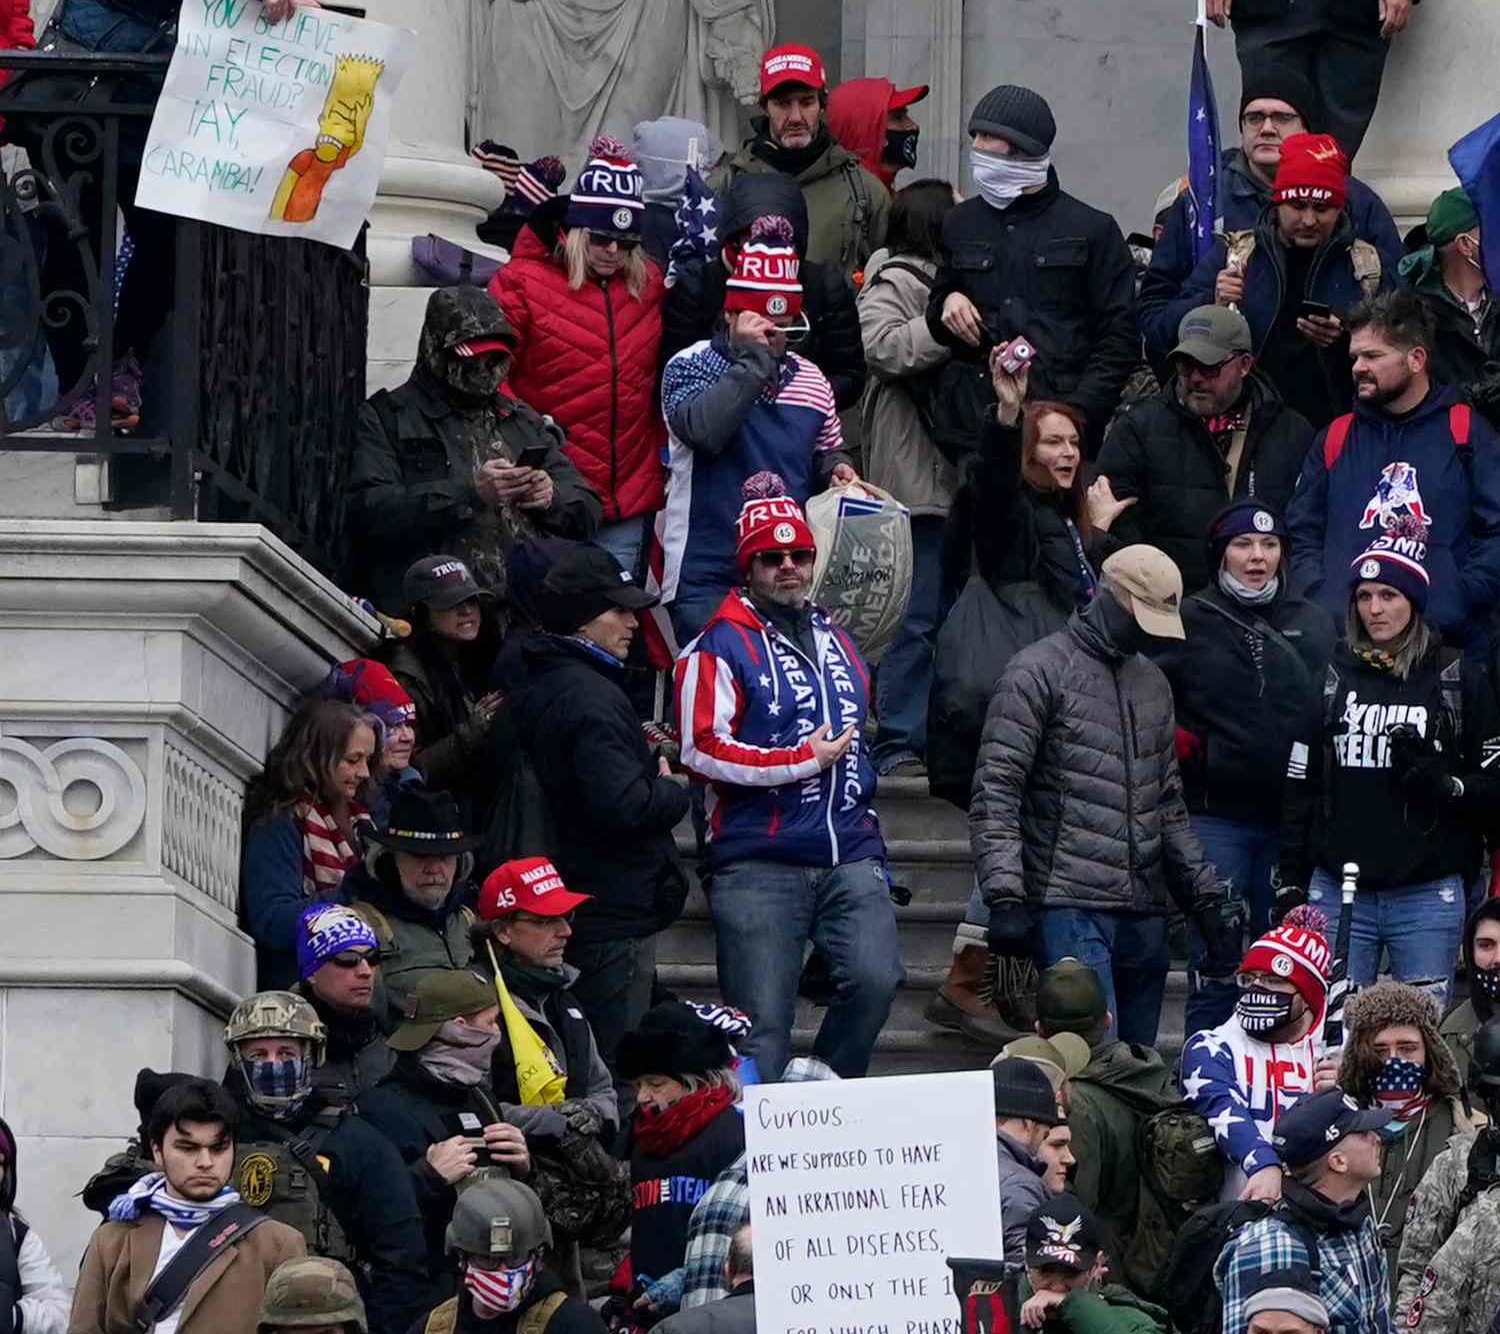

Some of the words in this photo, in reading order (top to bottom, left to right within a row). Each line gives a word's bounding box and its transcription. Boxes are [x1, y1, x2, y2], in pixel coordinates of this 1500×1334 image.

[182, 31, 211, 60] IN
[225, 38, 329, 86] ELECTION
[206, 66, 304, 107] FRAUD?
[146, 145, 266, 196] CARAMBA!
[1281, 185, 1332, 201] TRUMP
[769, 641, 816, 712] GREAT
[496, 888, 517, 908] 45
[1321, 1124, 1339, 1142] 45
[751, 1153, 776, 1175] ARE
[779, 1150, 801, 1171] WE
[802, 1147, 867, 1171] SUPPOSED
[874, 1145, 894, 1167] TO
[903, 1143, 942, 1166] HAVE
[766, 1193, 787, 1217] AN
[797, 1188, 888, 1215] IRRATIONAL
[900, 1183, 946, 1210] FEAR
[775, 1241, 795, 1261] OF
[806, 1237, 838, 1259] ALL
[847, 1230, 945, 1257] DISEASES,
[791, 1285, 814, 1305] OR
[828, 1279, 875, 1301] ONLY
[888, 1276, 928, 1297] THE
